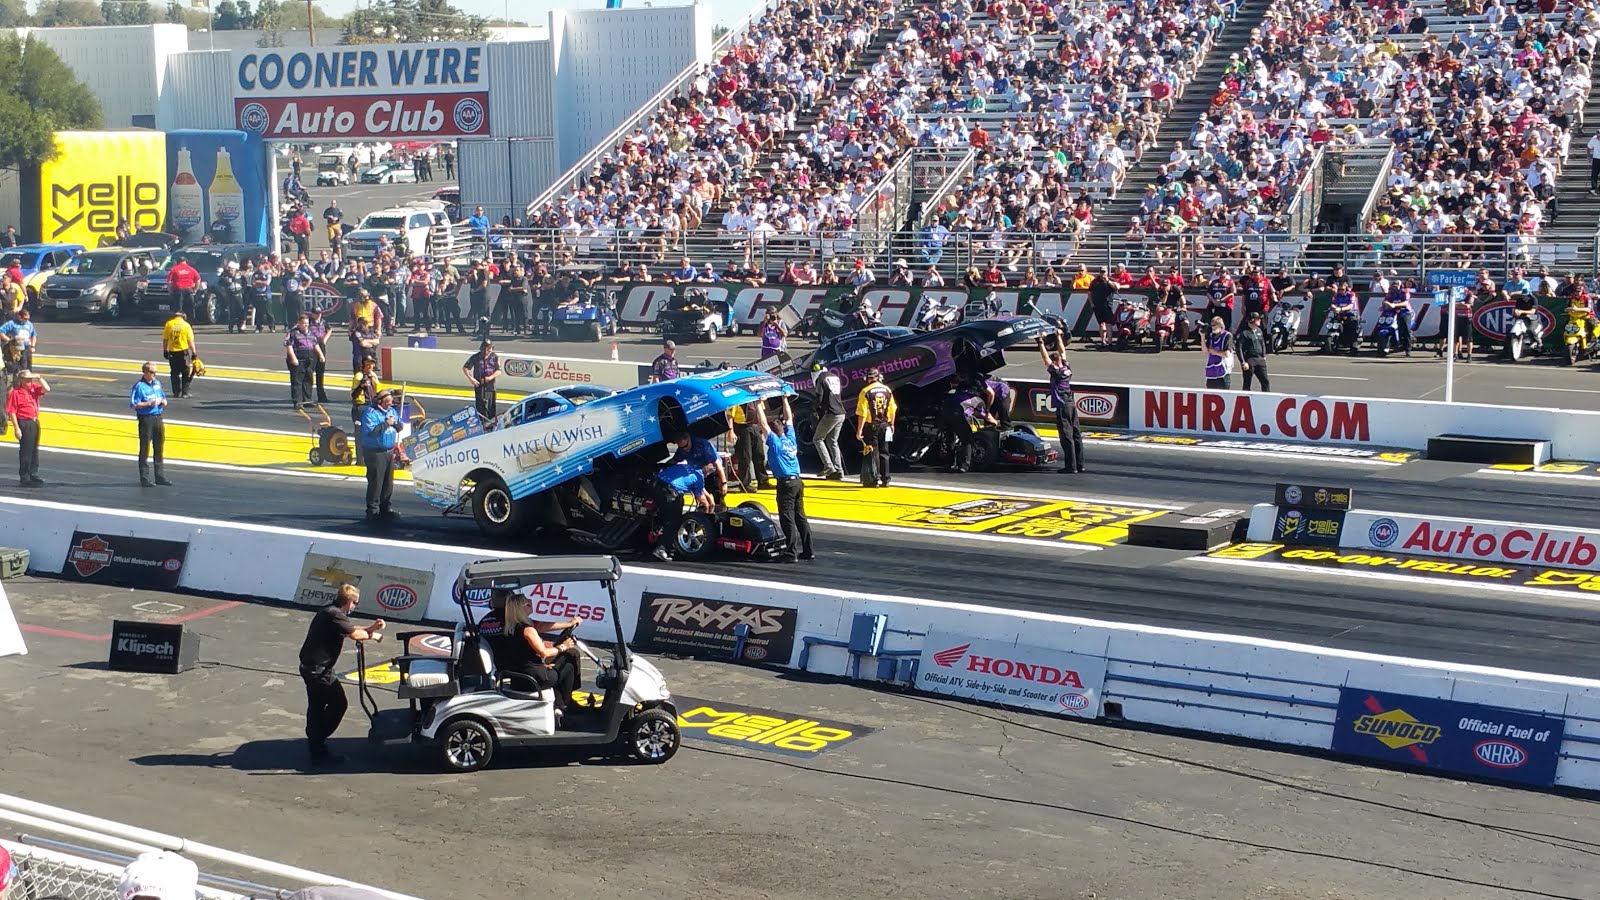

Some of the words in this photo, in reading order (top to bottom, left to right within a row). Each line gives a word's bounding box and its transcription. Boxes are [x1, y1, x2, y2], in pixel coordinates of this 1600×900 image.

[238, 50, 378, 91] COONER
[387, 47, 482, 86] WIRE
[273, 102, 355, 134] Auto
[364, 99, 445, 133] Club
[1440, 274, 1465, 283] Parker
[508, 362, 528, 373] NHRA
[543, 371, 592, 382] ACCESS
[547, 362, 570, 371] ALL
[851, 357, 921, 380] assciation
[1036, 394, 1057, 412] FO
[1081, 399, 1108, 412] NHRA
[1144, 390, 1371, 442] NHRA.COM
[424, 448, 480, 470] wish.org
[1281, 549, 1517, 578] GO-ON-YELLO!
[302, 588, 338, 601] CHEVR
[382, 588, 412, 606] NHRA
[530, 583, 569, 600] ALL
[532, 599, 606, 622] CCESS
[650, 597, 786, 635] TRAXXAS
[656, 625, 669, 633] The
[668, 627, 694, 636] Fastest
[694, 630, 714, 639] Name
[745, 637, 770, 645] ontrol
[117, 638, 174, 655] Klipsch
[966, 654, 1085, 689] HONDA
[924, 672, 949, 684] Official
[949, 676, 964, 688] ATV,
[965, 678, 1008, 695] Side-by-Side
[1008, 687, 1021, 697] and
[1022, 689, 1047, 702] Scooter
[1049, 693, 1058, 702] of
[1062, 696, 1086, 708] NHRA
[1356, 716, 1439, 742] SUNOCO
[1458, 717, 1501, 735] Official
[1505, 725, 1532, 741] Fuel
[1534, 730, 1551, 742] of
[1481, 743, 1521, 764] NHRA
